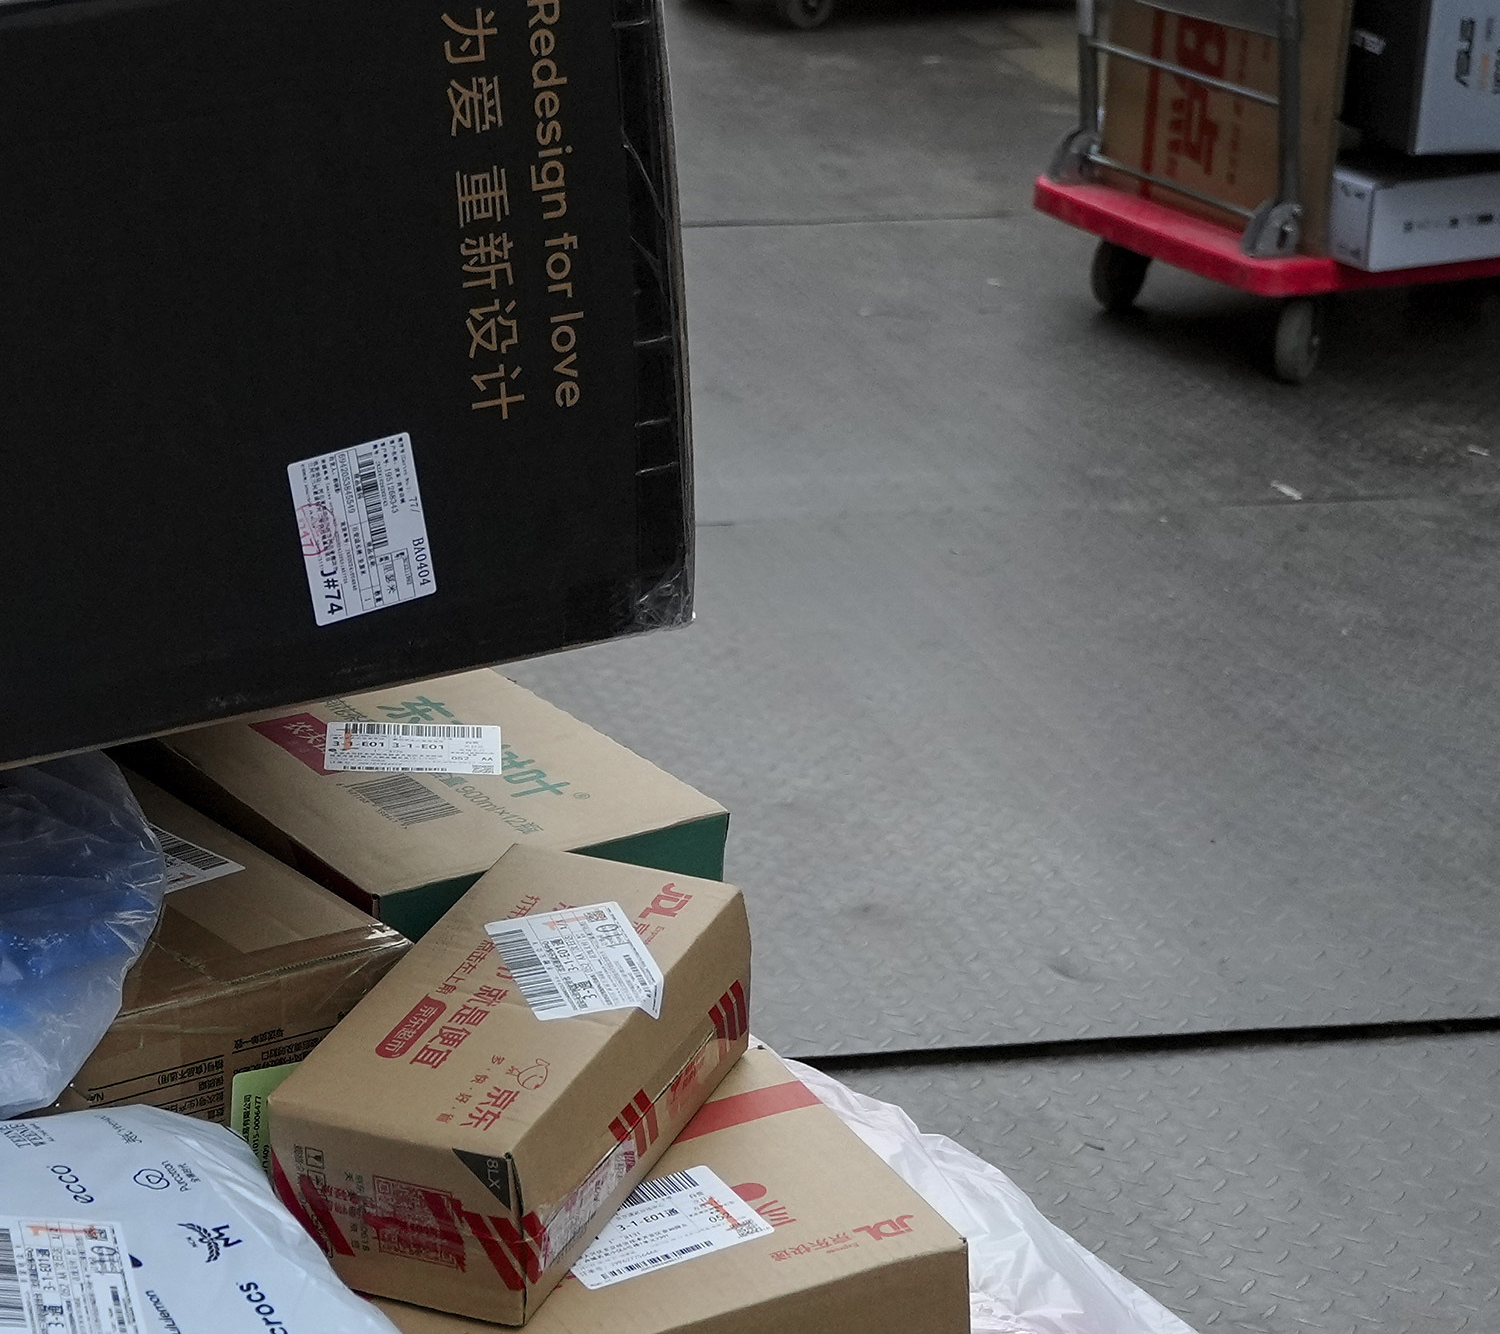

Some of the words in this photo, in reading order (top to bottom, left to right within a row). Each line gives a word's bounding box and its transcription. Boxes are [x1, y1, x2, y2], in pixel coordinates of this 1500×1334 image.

[441, 5, 505, 137] 为爱
[454, 166, 525, 423] 重新设计
[545, 228, 579, 295] for
[552, 307, 582, 411] love
[412, 537, 431, 587] BA0404
[638, 882, 693, 920] JDL
[409, 986, 509, 1070] 就是便宜
[459, 1085, 521, 1133] 京东
[852, 1212, 916, 1242] JDL
